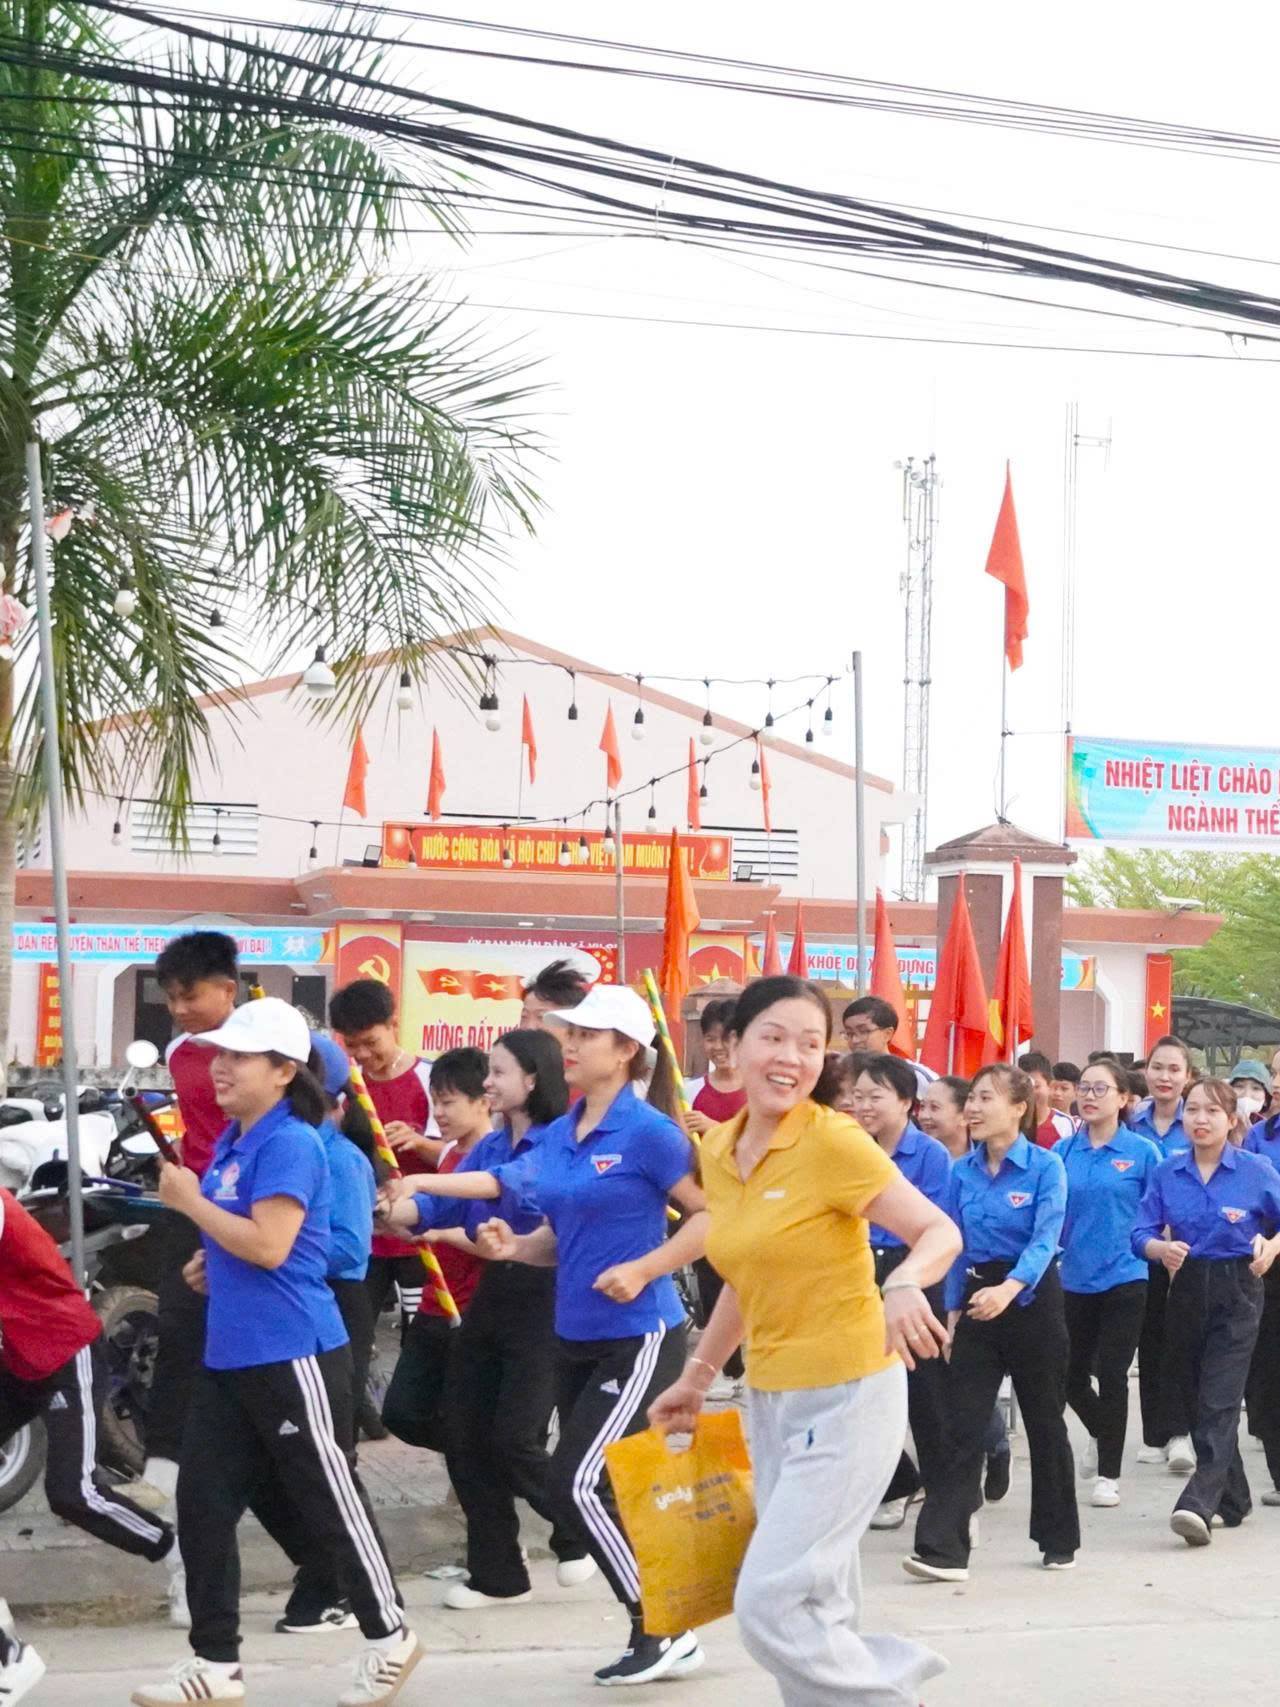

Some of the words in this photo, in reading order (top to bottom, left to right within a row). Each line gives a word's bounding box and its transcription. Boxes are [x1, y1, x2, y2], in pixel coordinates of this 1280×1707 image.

[1106, 757, 1165, 795] NHIỆT
[1171, 759, 1212, 797] LIỆT
[1218, 762, 1271, 795] CHÀO
[1167, 800, 1239, 834] NGÀNH
[422, 832, 449, 861] NƯỚC
[451, 832, 479, 866] CỘNG
[518, 834, 535, 868] HỘI
[422, 1018, 464, 1051] MỪNG
